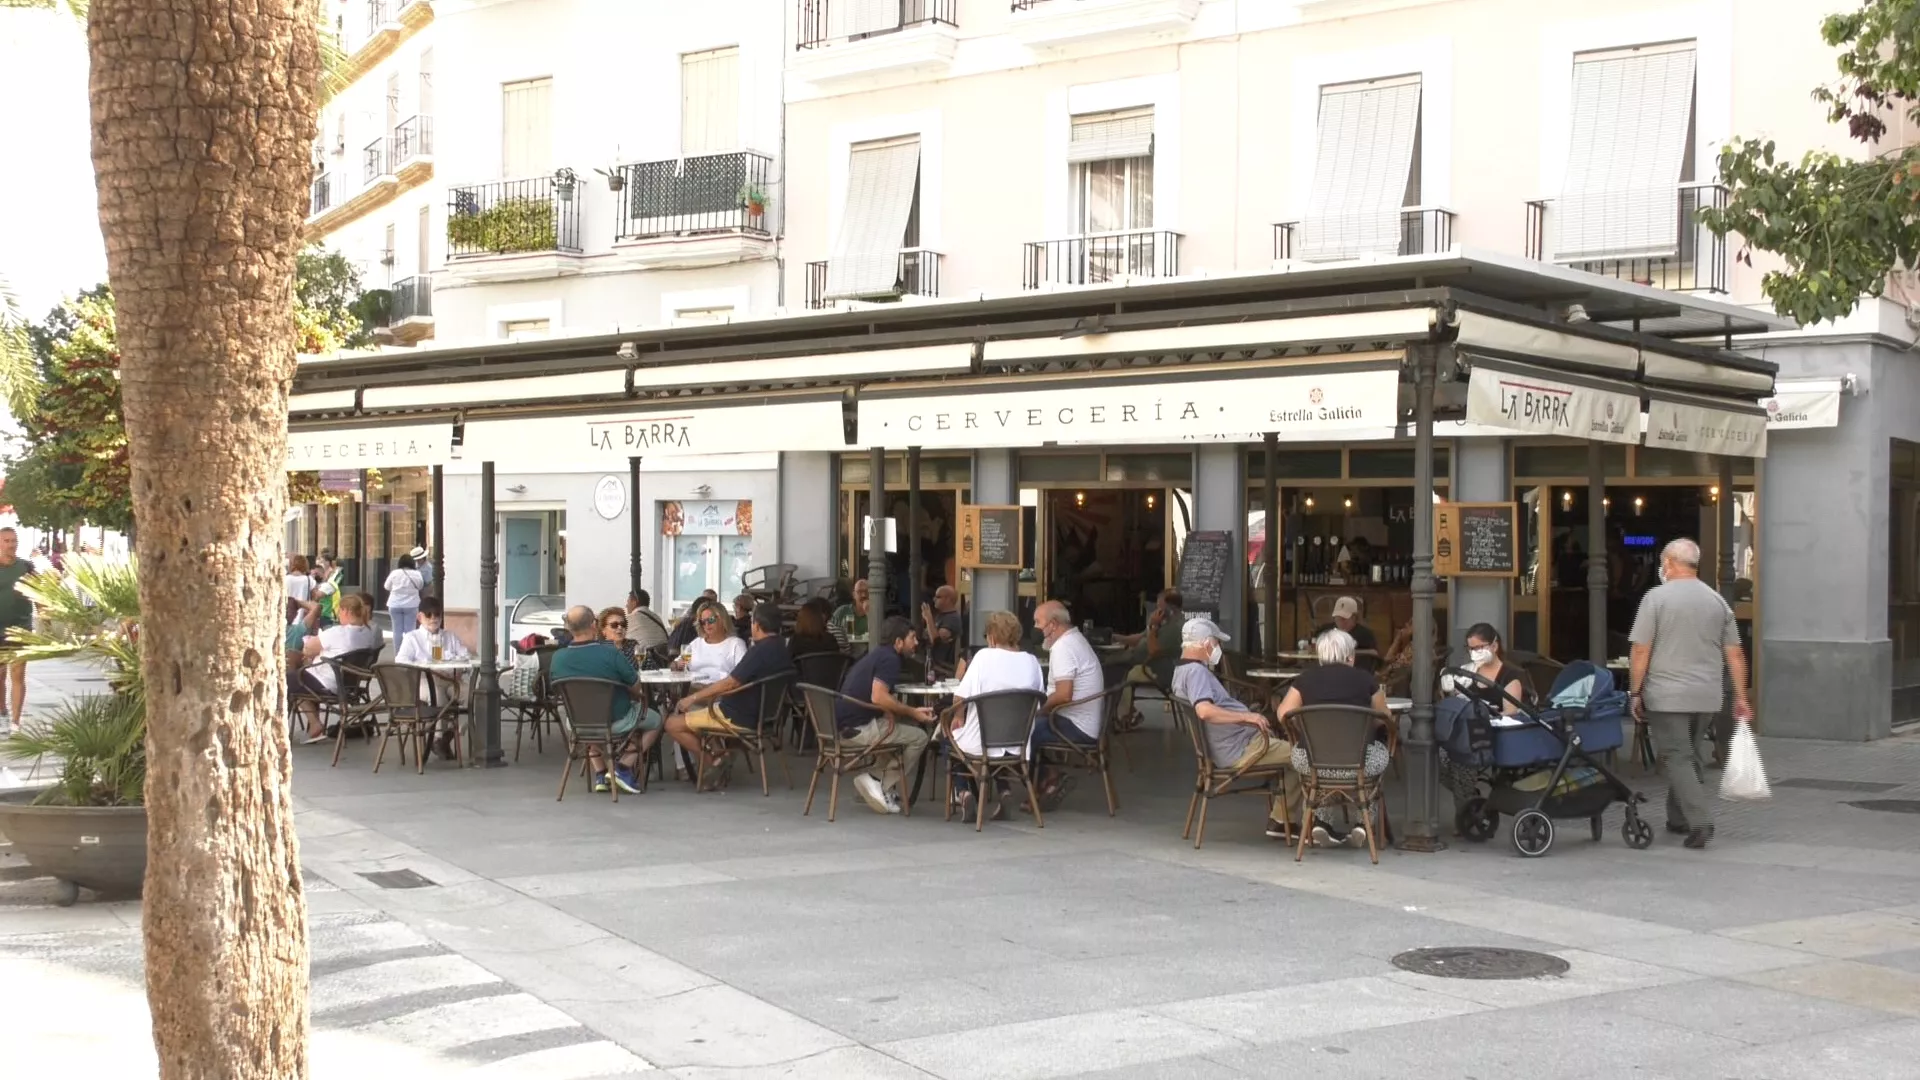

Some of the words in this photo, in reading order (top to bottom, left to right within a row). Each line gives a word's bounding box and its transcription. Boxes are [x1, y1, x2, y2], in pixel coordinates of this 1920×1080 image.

[908, 398, 1200, 431] CERVECERÍA
[1269, 409, 1313, 423] Estrella
[1318, 406, 1362, 421] Galicia
[1500, 387, 1517, 420] LA
[1524, 391, 1569, 427] BARRA
[1775, 412, 1808, 422] Galicia
[590, 427, 612, 451] LA
[625, 423, 691, 448] BARRA
